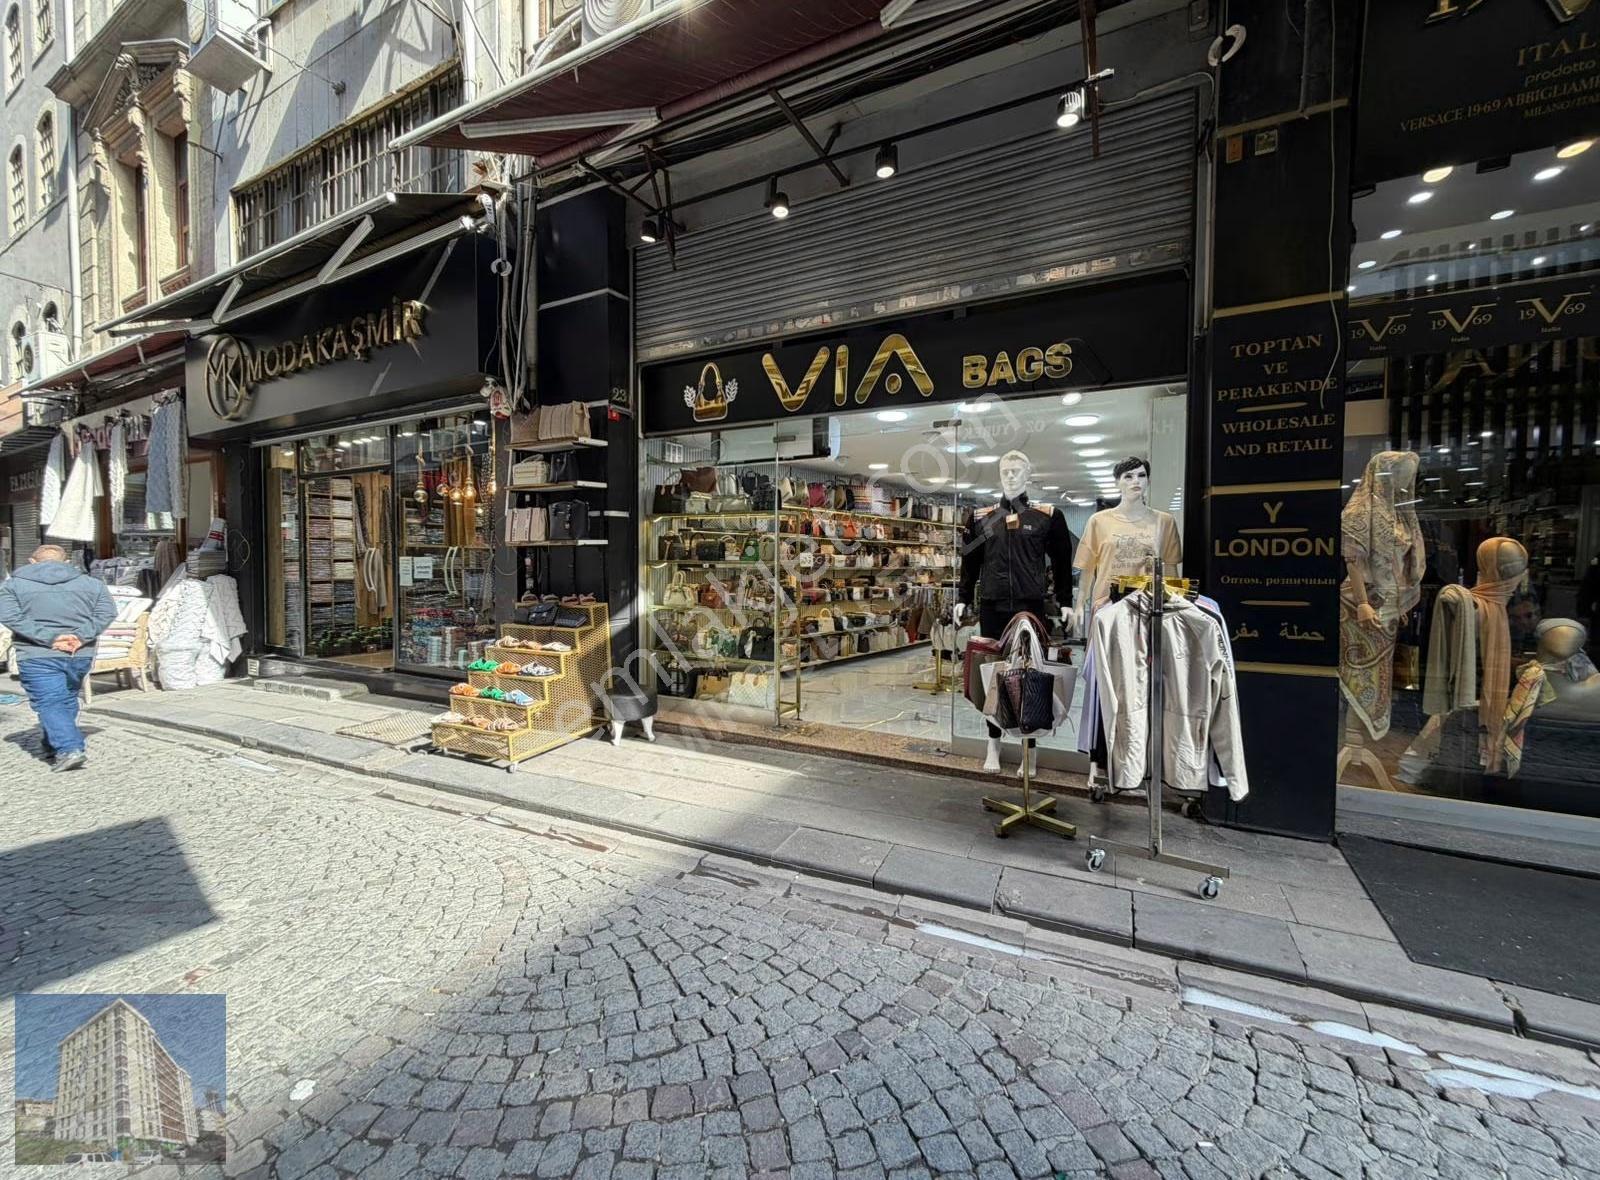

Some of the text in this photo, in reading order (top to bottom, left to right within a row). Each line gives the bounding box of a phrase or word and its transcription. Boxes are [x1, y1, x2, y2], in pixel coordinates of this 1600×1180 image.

[1525, 60, 1597, 88] prodotto
[1400, 107, 1464, 132] VERSACE
[1467, 100, 1502, 118] 1969
[246, 297, 425, 384] MODAKAŞMİR
[1230, 334, 1323, 358] TOPTAN
[762, 333, 1073, 411] VIA BAGS
[1263, 362, 1288, 375] VE
[612, 388, 628, 402] 23
[1217, 377, 1338, 402] PERAKENDE
[1222, 413, 1336, 435] WHOLESALE
[1224, 438, 1333, 457] AND RETAIL
[1263, 501, 1284, 523] Y
[1214, 537, 1335, 557] LONDON
